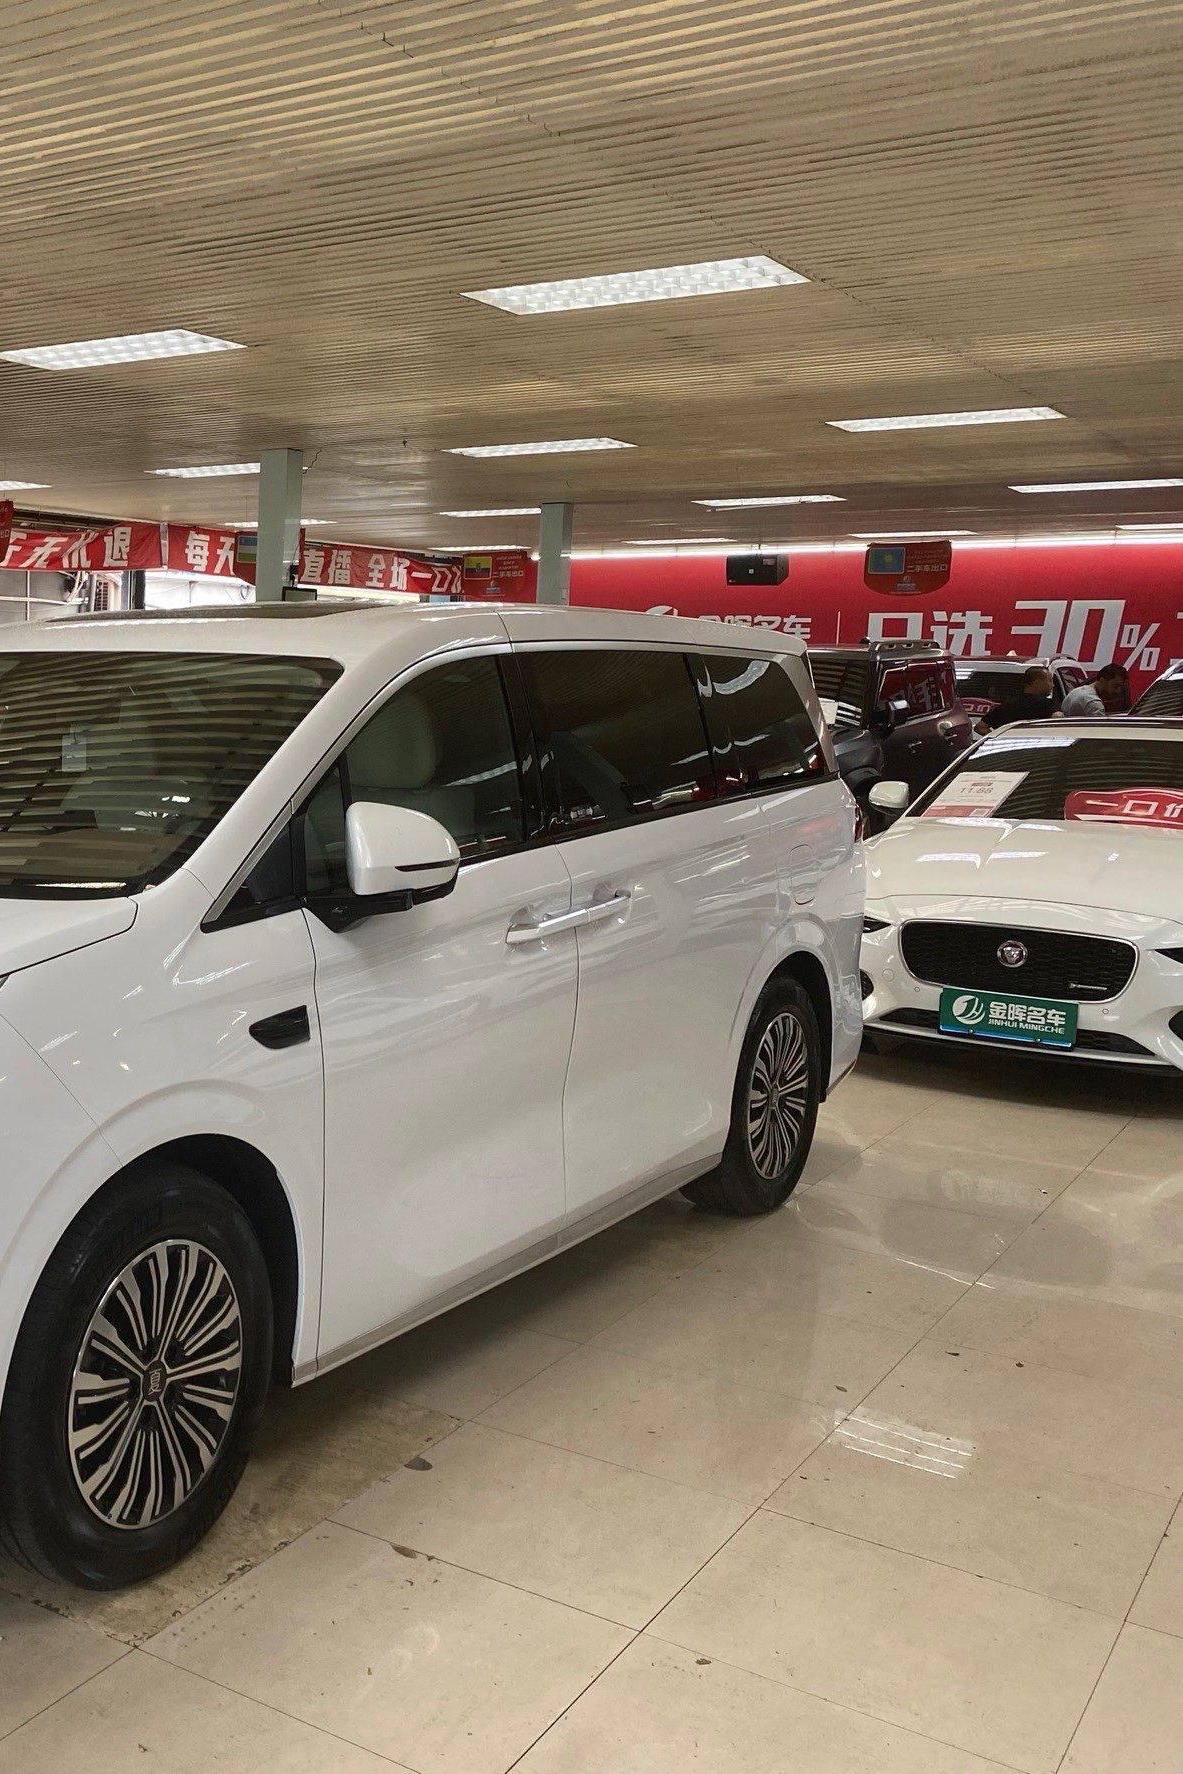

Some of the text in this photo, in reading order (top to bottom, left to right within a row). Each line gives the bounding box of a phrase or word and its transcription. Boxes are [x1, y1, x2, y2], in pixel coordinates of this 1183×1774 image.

[906, 563, 948, 573] 二手车出口
[988, 1001, 1066, 1027] 金晖名车
[988, 1018, 1066, 1035] JINHUI MINGCHE
